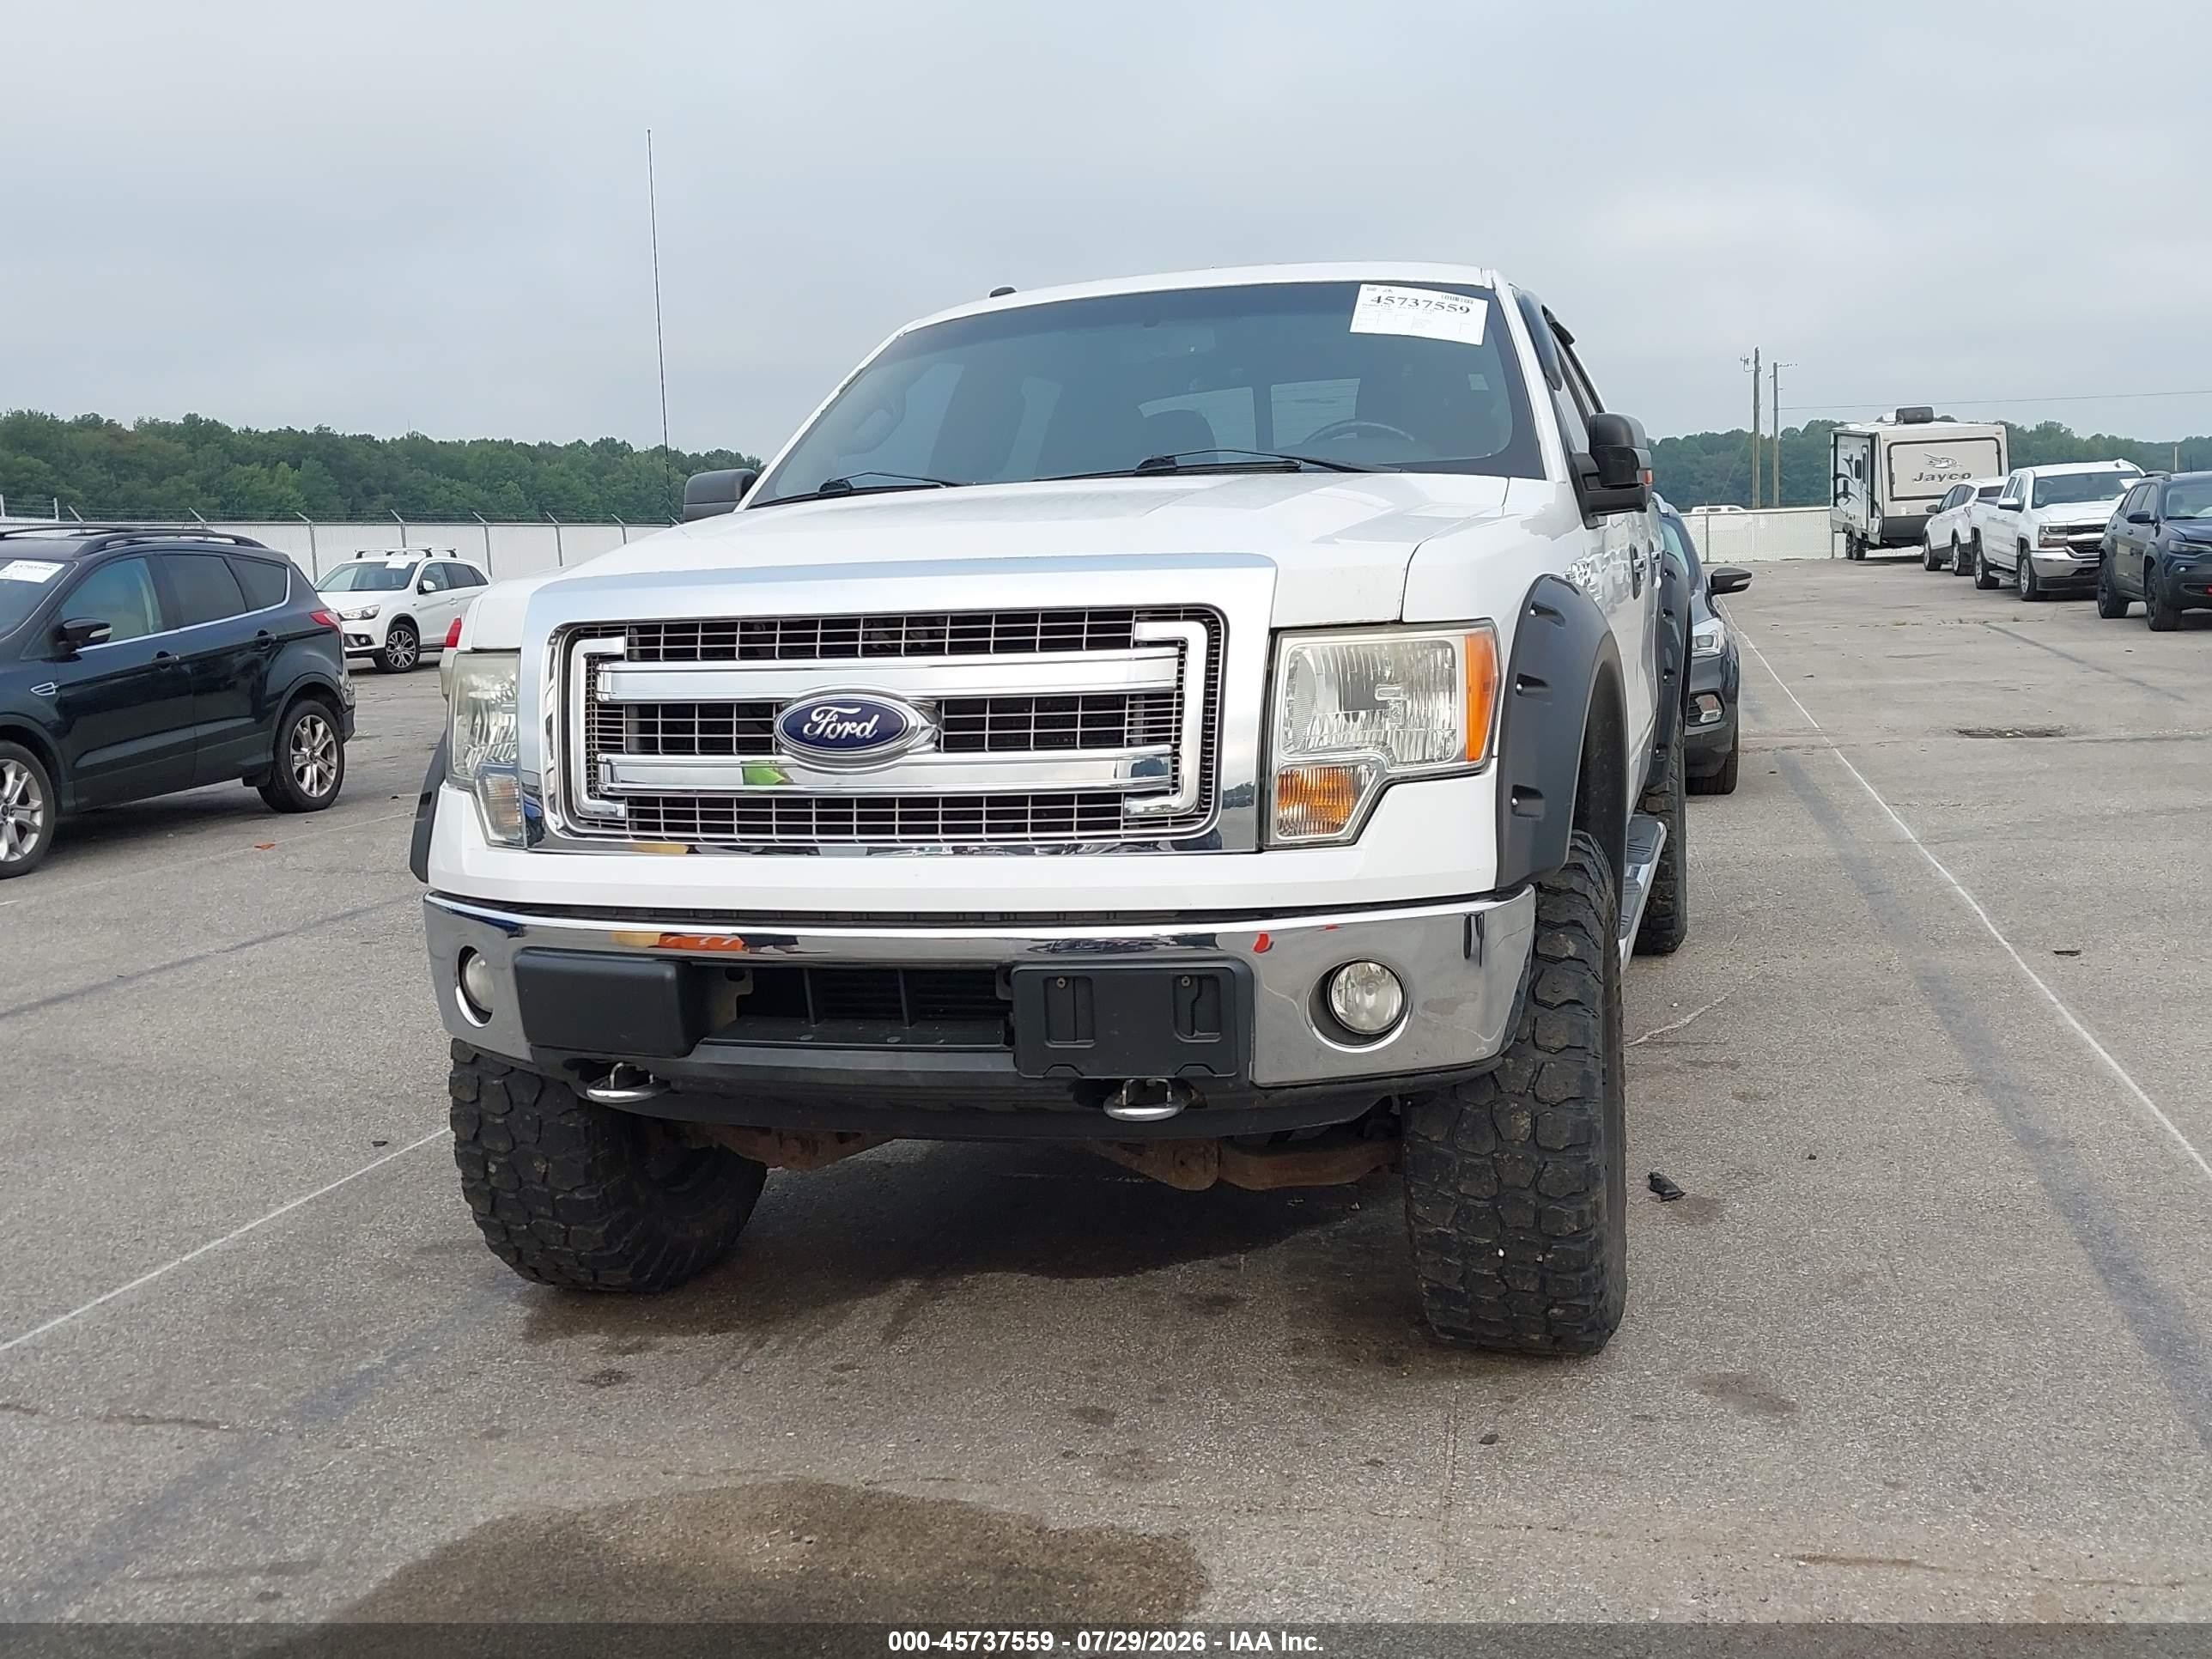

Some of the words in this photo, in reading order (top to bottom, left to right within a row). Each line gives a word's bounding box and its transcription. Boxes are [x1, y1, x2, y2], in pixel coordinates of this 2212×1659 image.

[1370, 295, 1470, 314] 45737559
[1913, 472, 1972, 483] Jayco
[804, 706, 879, 739] Ford
